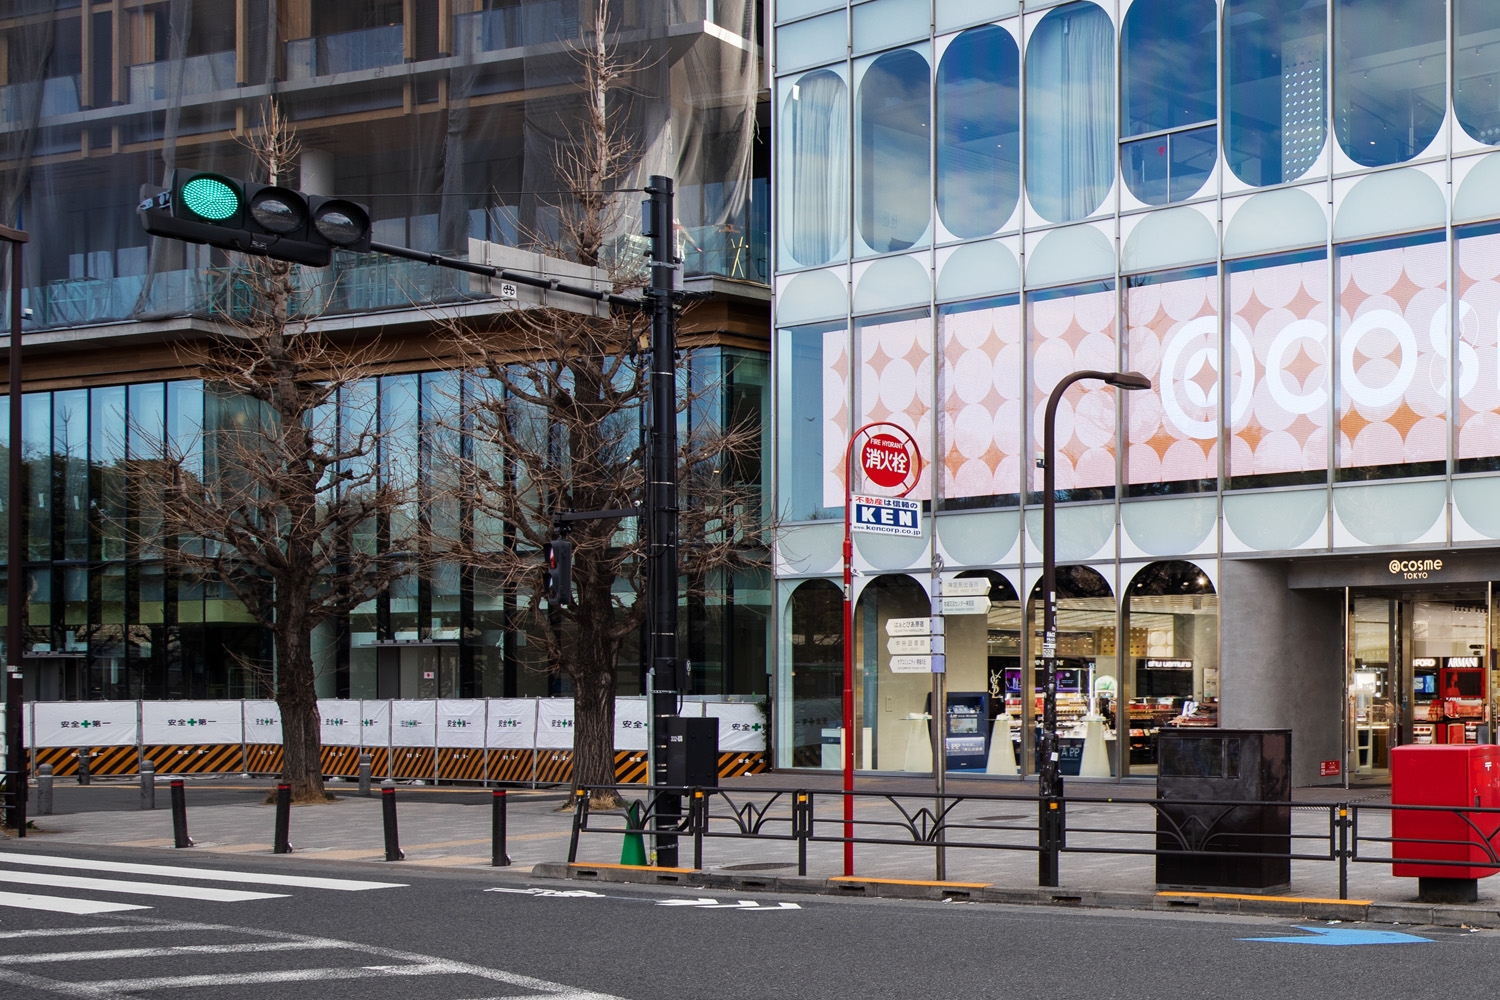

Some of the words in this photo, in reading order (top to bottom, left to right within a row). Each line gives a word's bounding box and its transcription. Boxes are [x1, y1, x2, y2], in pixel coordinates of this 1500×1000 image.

[870, 438, 881, 446] FIRE
[882, 440, 904, 450] HYDRANT
[866, 447, 907, 474] 消火栓
[855, 495, 918, 509] 不動産は信頼の
[861, 506, 912, 527] KEN
[853, 524, 920, 536] www.kencorp.co.jp
[1389, 559, 1443, 574] @cosme
[1403, 571, 1428, 580] TOKYO
[1447, 657, 1478, 668] ARMANI
